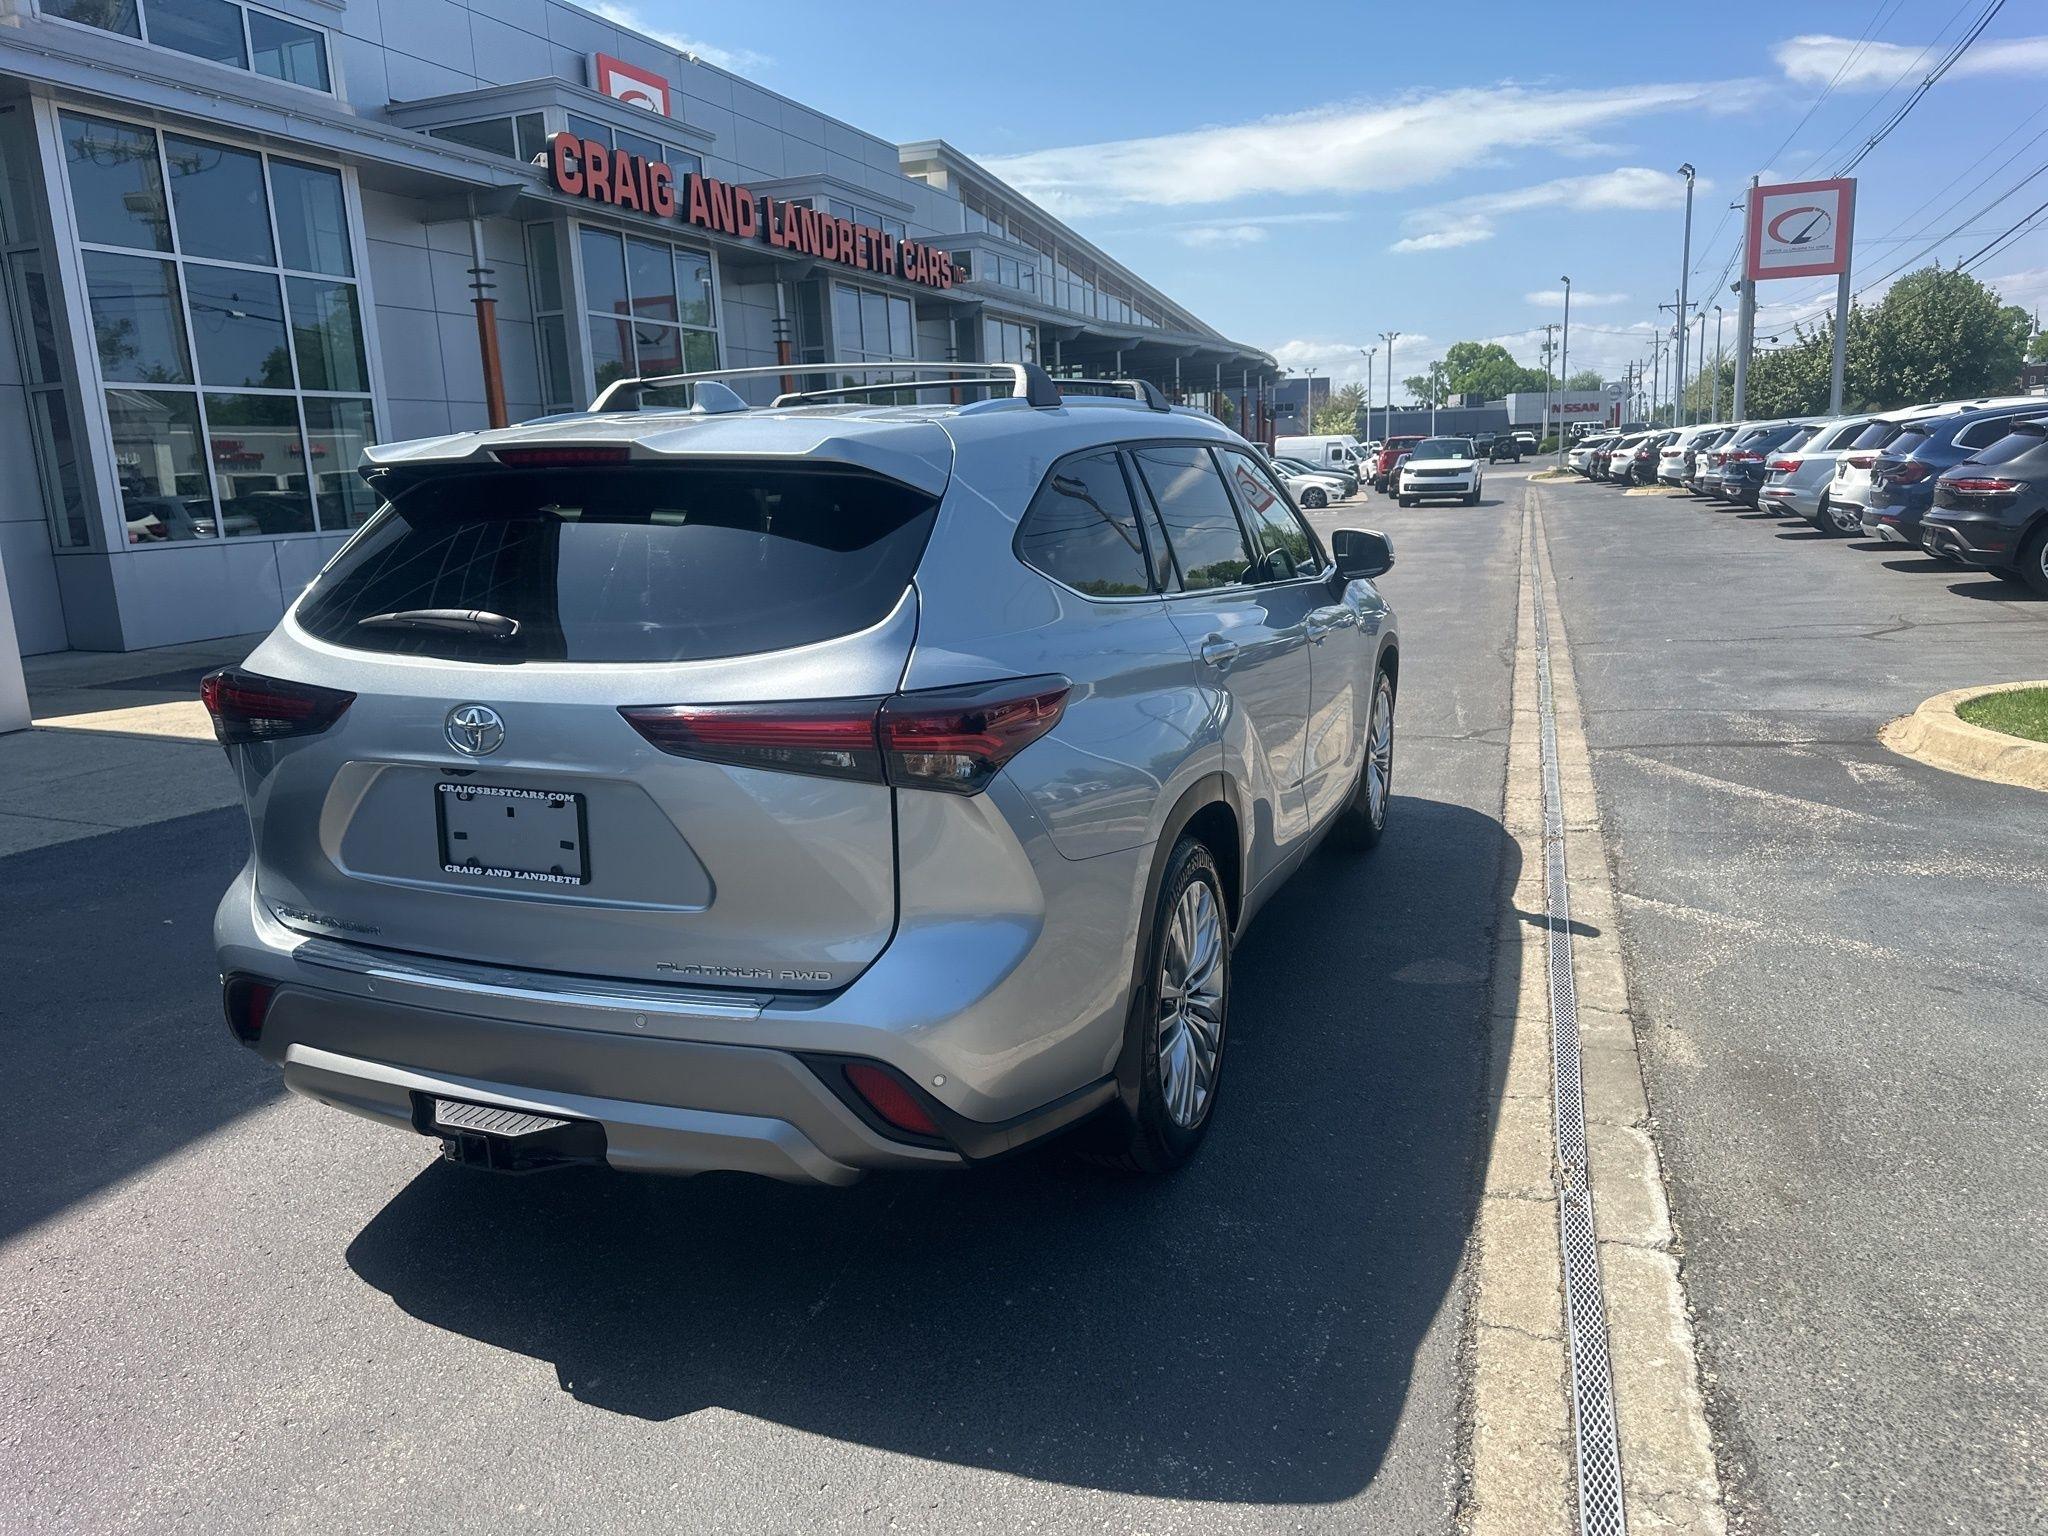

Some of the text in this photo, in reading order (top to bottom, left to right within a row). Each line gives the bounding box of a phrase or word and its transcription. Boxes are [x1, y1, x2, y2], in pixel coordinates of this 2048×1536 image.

[548, 131, 676, 218] CRAIG
[683, 172, 756, 238] AND
[763, 196, 895, 275] LANDRETH
[898, 239, 953, 289] CARS
[1551, 402, 1600, 414] NSSAN
[438, 784, 575, 802] CRAIGSBESTCARS.COM
[444, 864, 581, 885] CRAIG AND LANDRETH
[656, 961, 833, 982] PLATINUM AWD
